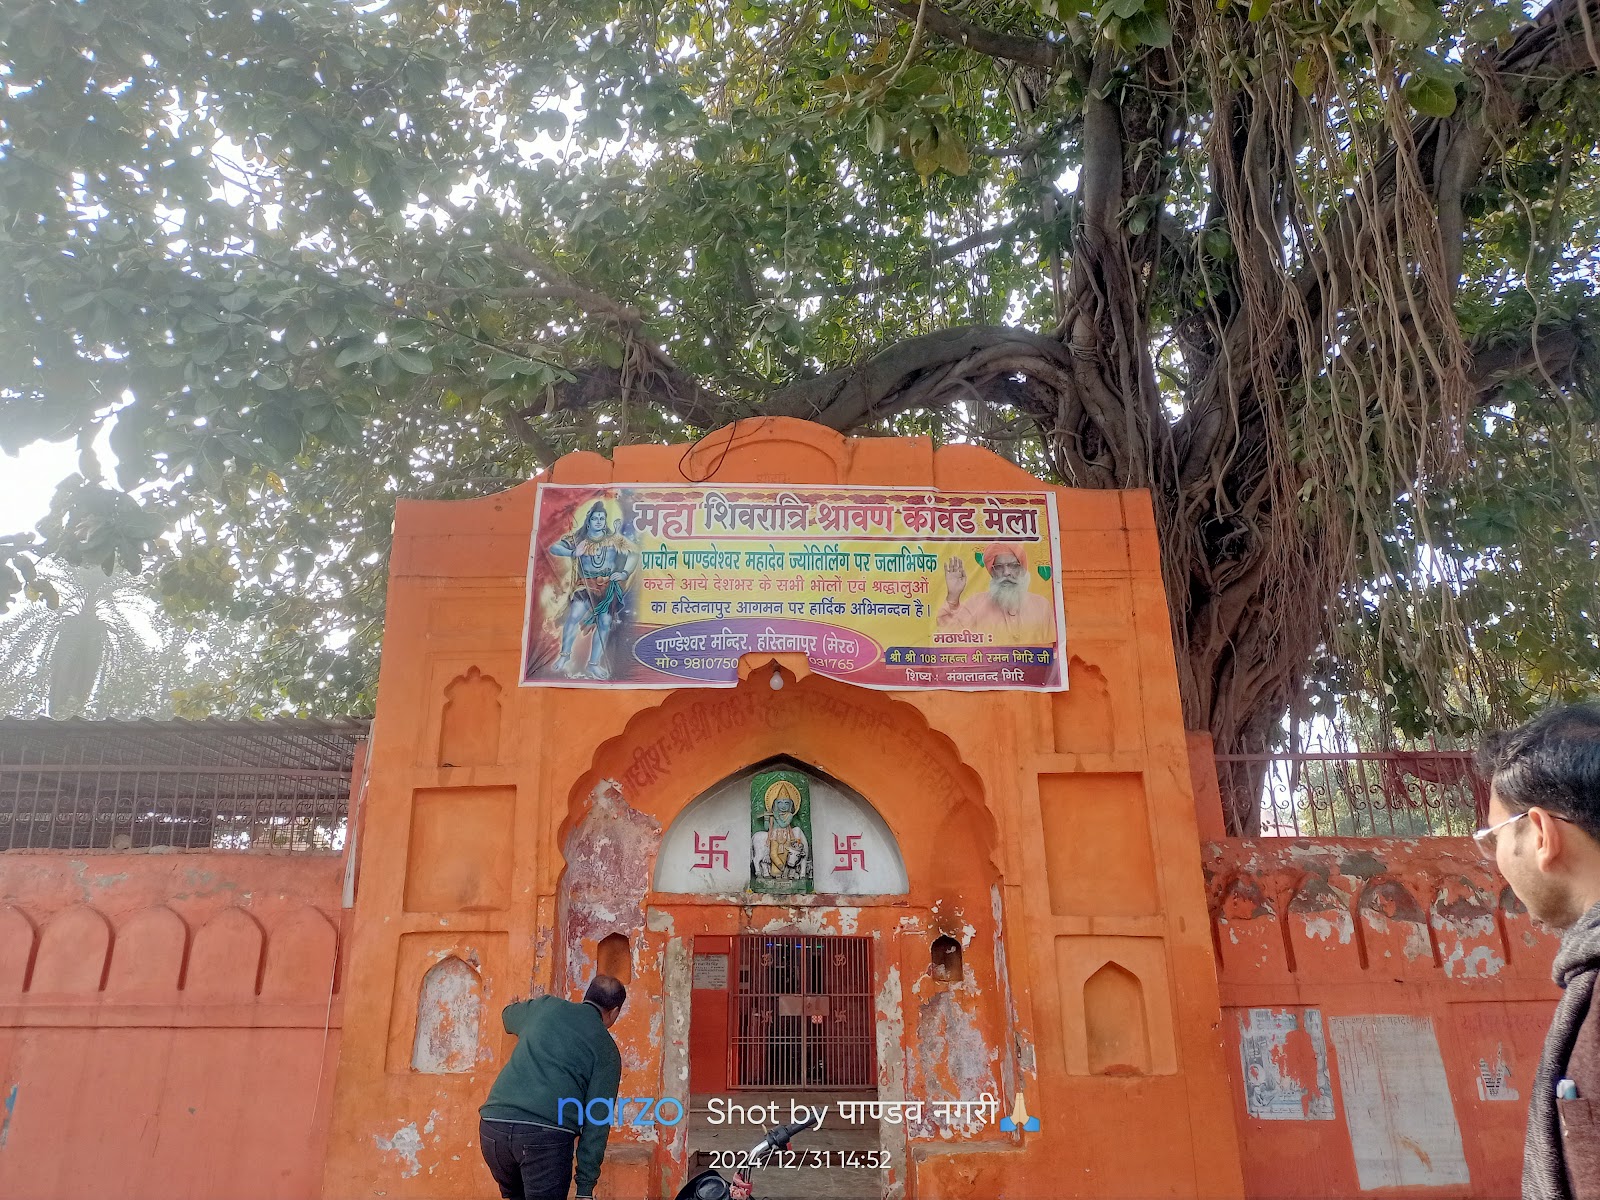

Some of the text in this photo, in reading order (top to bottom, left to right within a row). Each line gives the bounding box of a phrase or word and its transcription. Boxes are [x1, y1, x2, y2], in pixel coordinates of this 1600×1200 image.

[635, 491, 1039, 539] महा शिवरात्रि श्रावण कांवड मेला
[641, 543, 938, 573] प्राचीन पाण्डवेश्वर महादेव ज्योतिर्लिंग पर जलाभिषेक
[643, 573, 930, 599] करने आये देशभर के सभी भोलों एवं श्रद्धालुओं
[650, 600, 668, 614] का
[671, 595, 732, 619] हस्तिनापुर
[735, 601, 784, 614] आगमन
[788, 602, 805, 615] पर
[808, 596, 847, 616] हार्दिक
[850, 597, 911, 617] अभिनन्दन
[655, 630, 707, 653] पाण्डेश्वर
[756, 626, 818, 656] हस्तिनापुर
[822, 631, 860, 658] (मेरठ)
[933, 629, 985, 644] मठाधीश
[889, 649, 1051, 665] श्री श्री 108 महन्त श्री रमन गिरि जी
[905, 667, 932, 683] शिष्य
[945, 669, 999, 683] मंगलानन्द
[1001, 668, 1025, 683] गिरि
